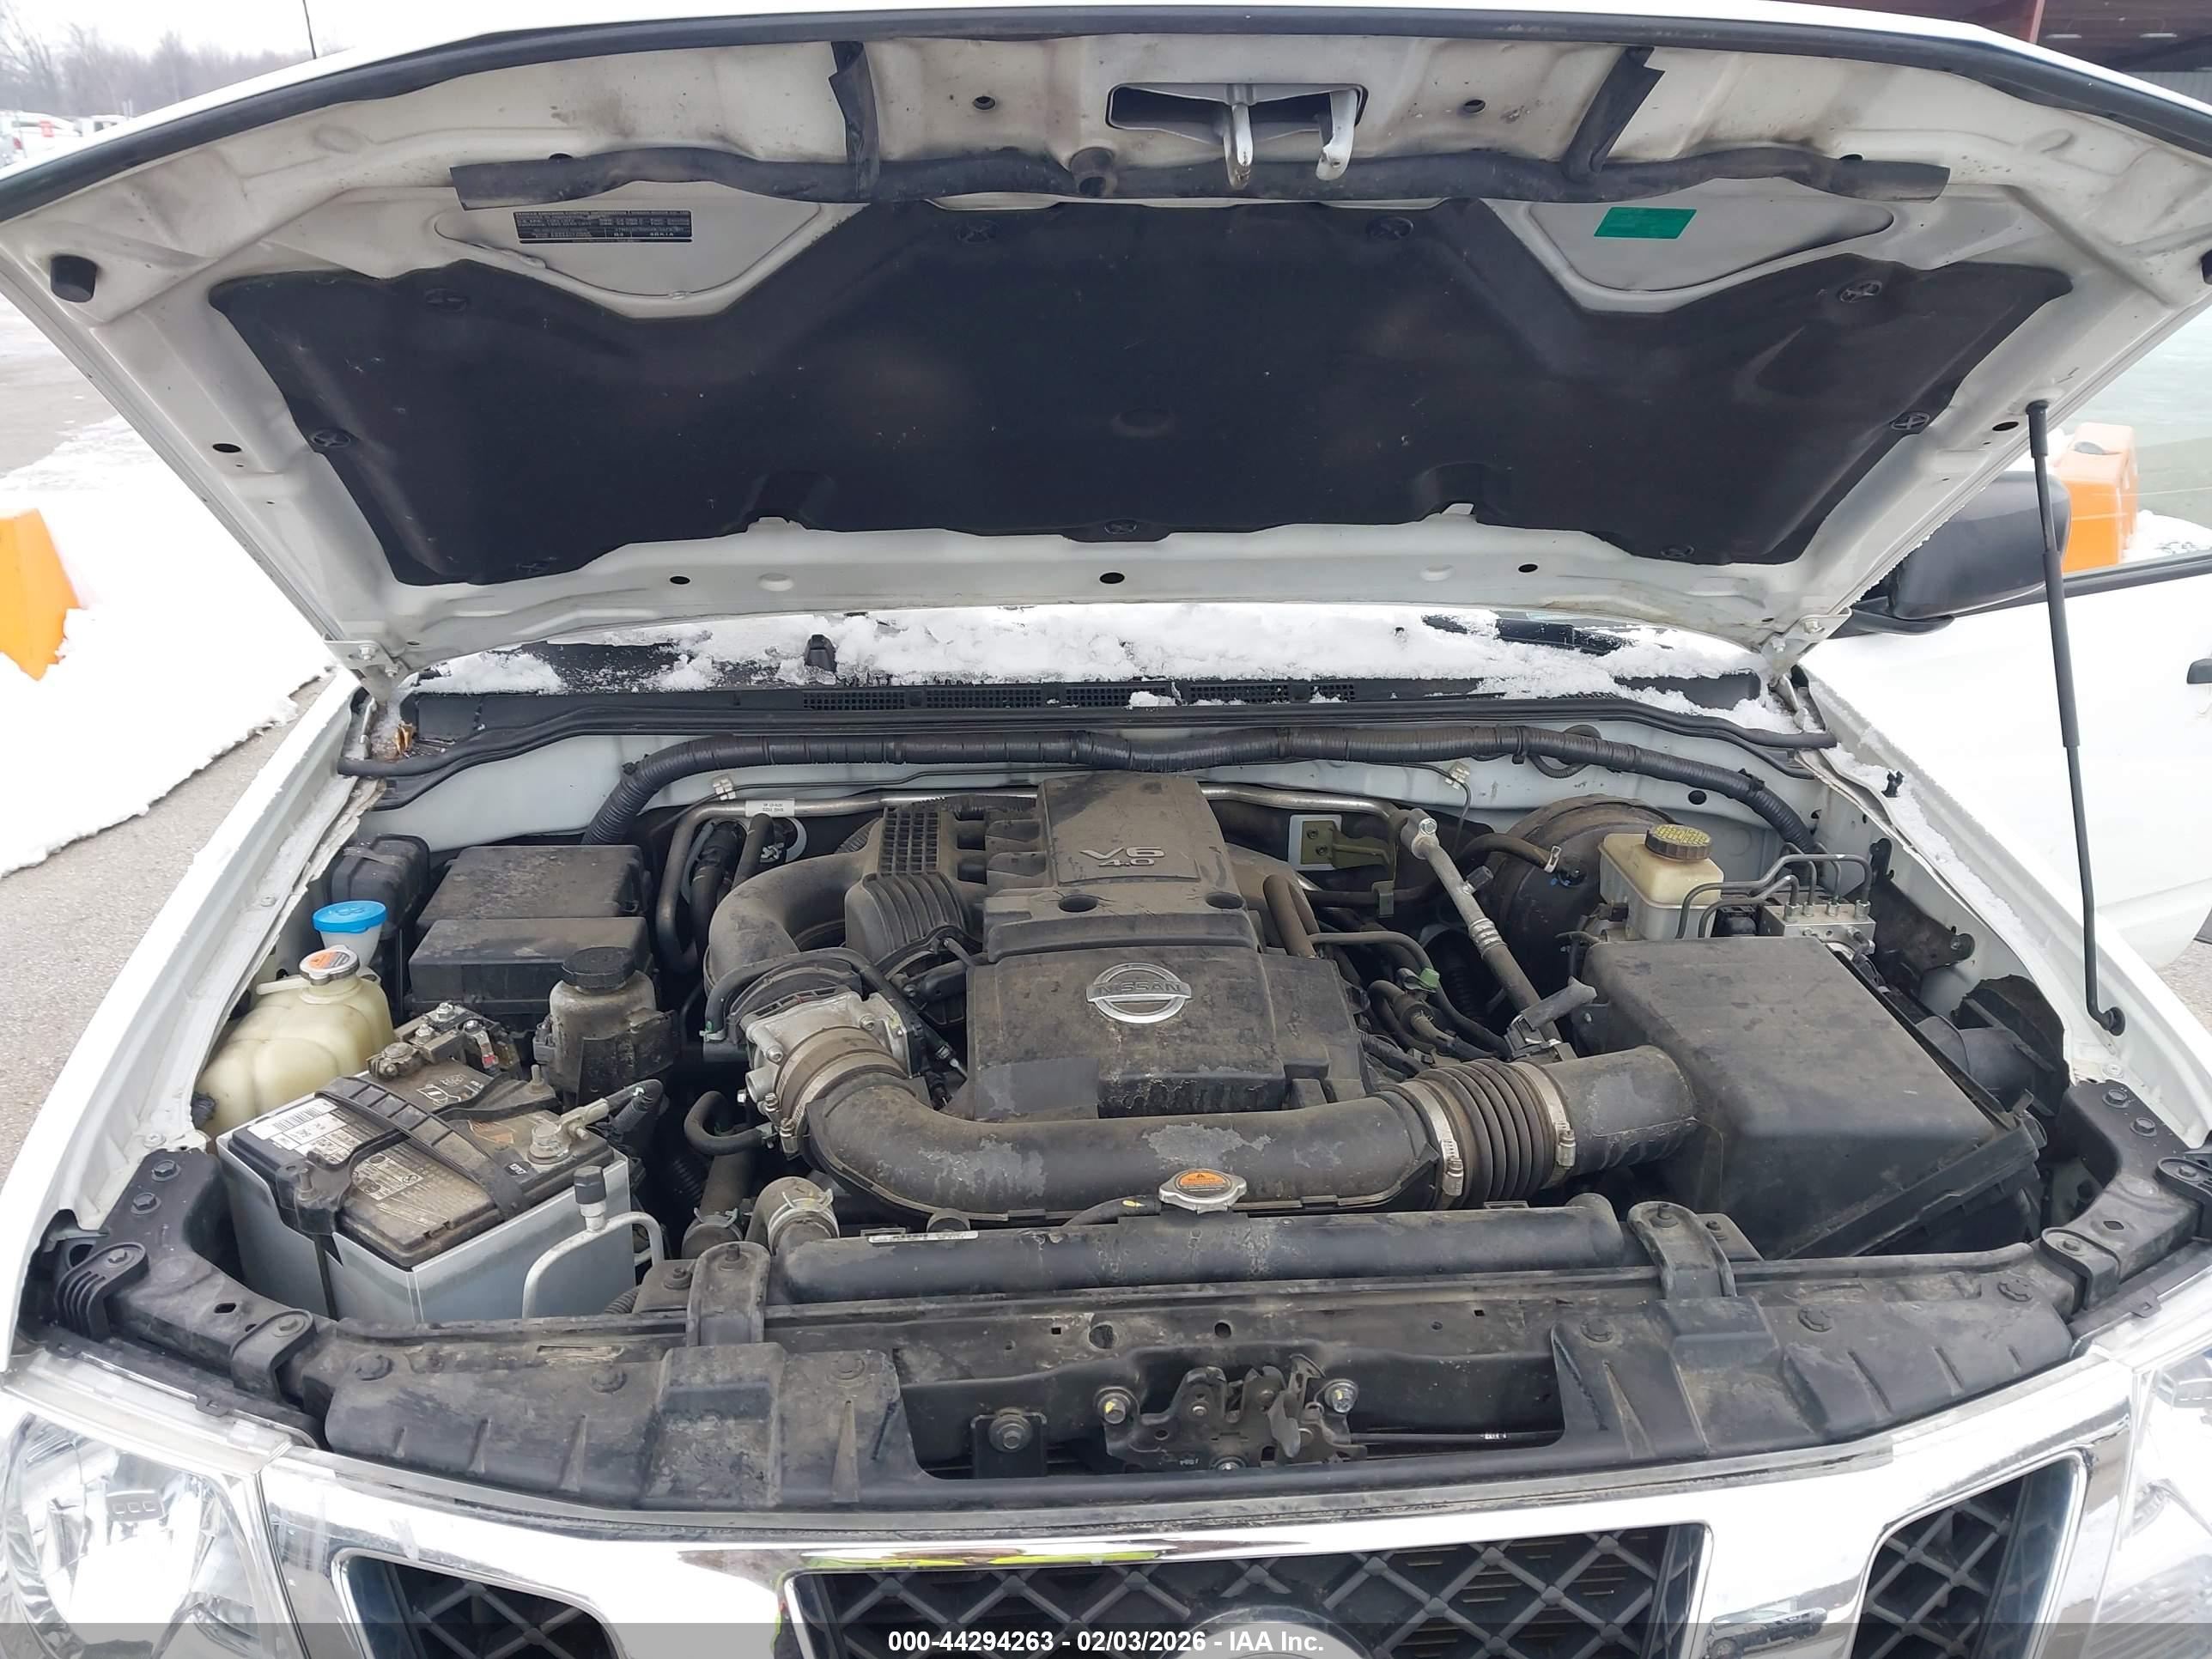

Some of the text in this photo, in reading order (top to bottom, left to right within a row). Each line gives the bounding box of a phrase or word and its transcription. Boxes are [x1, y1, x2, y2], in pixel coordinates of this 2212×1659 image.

[1079, 847, 1165, 860] V6
[1098, 857, 1155, 867] 4.0
[1097, 981, 1181, 994] NISSAN
